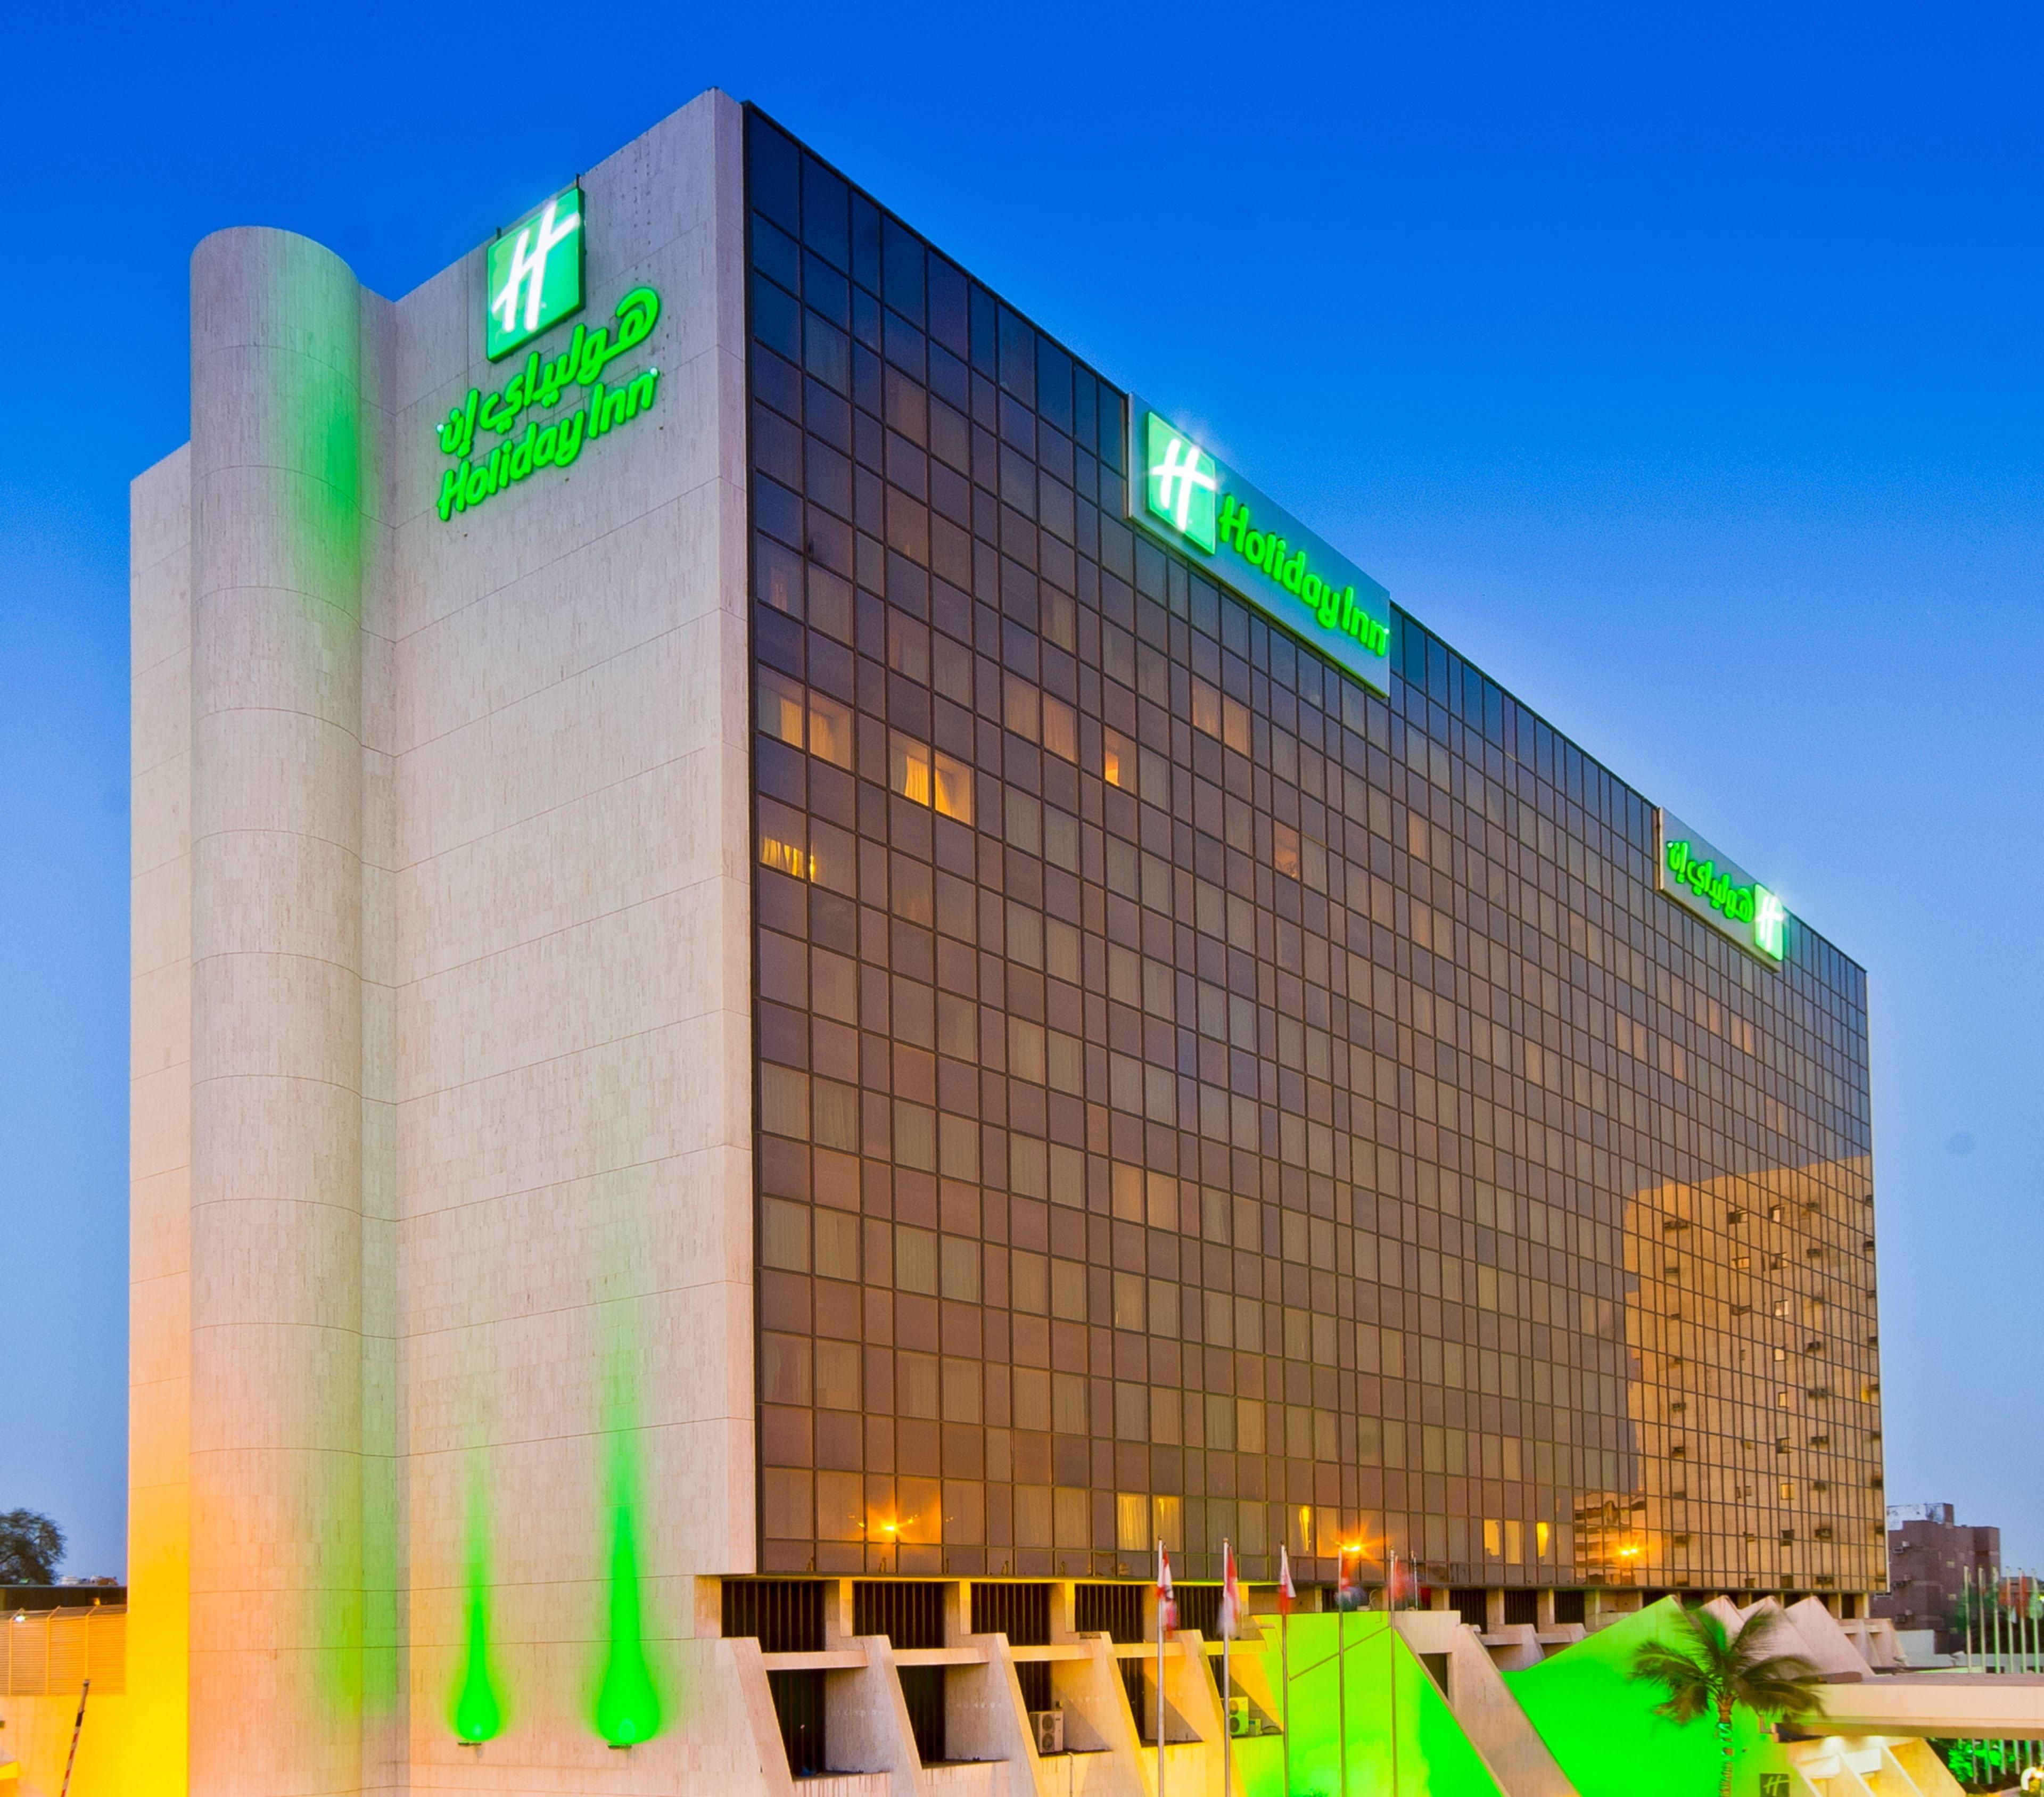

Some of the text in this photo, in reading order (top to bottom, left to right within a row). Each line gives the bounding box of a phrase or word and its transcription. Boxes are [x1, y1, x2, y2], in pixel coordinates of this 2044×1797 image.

[438, 373, 658, 521] Holiday Inn
[1218, 494, 1386, 657] Holiday Inn
